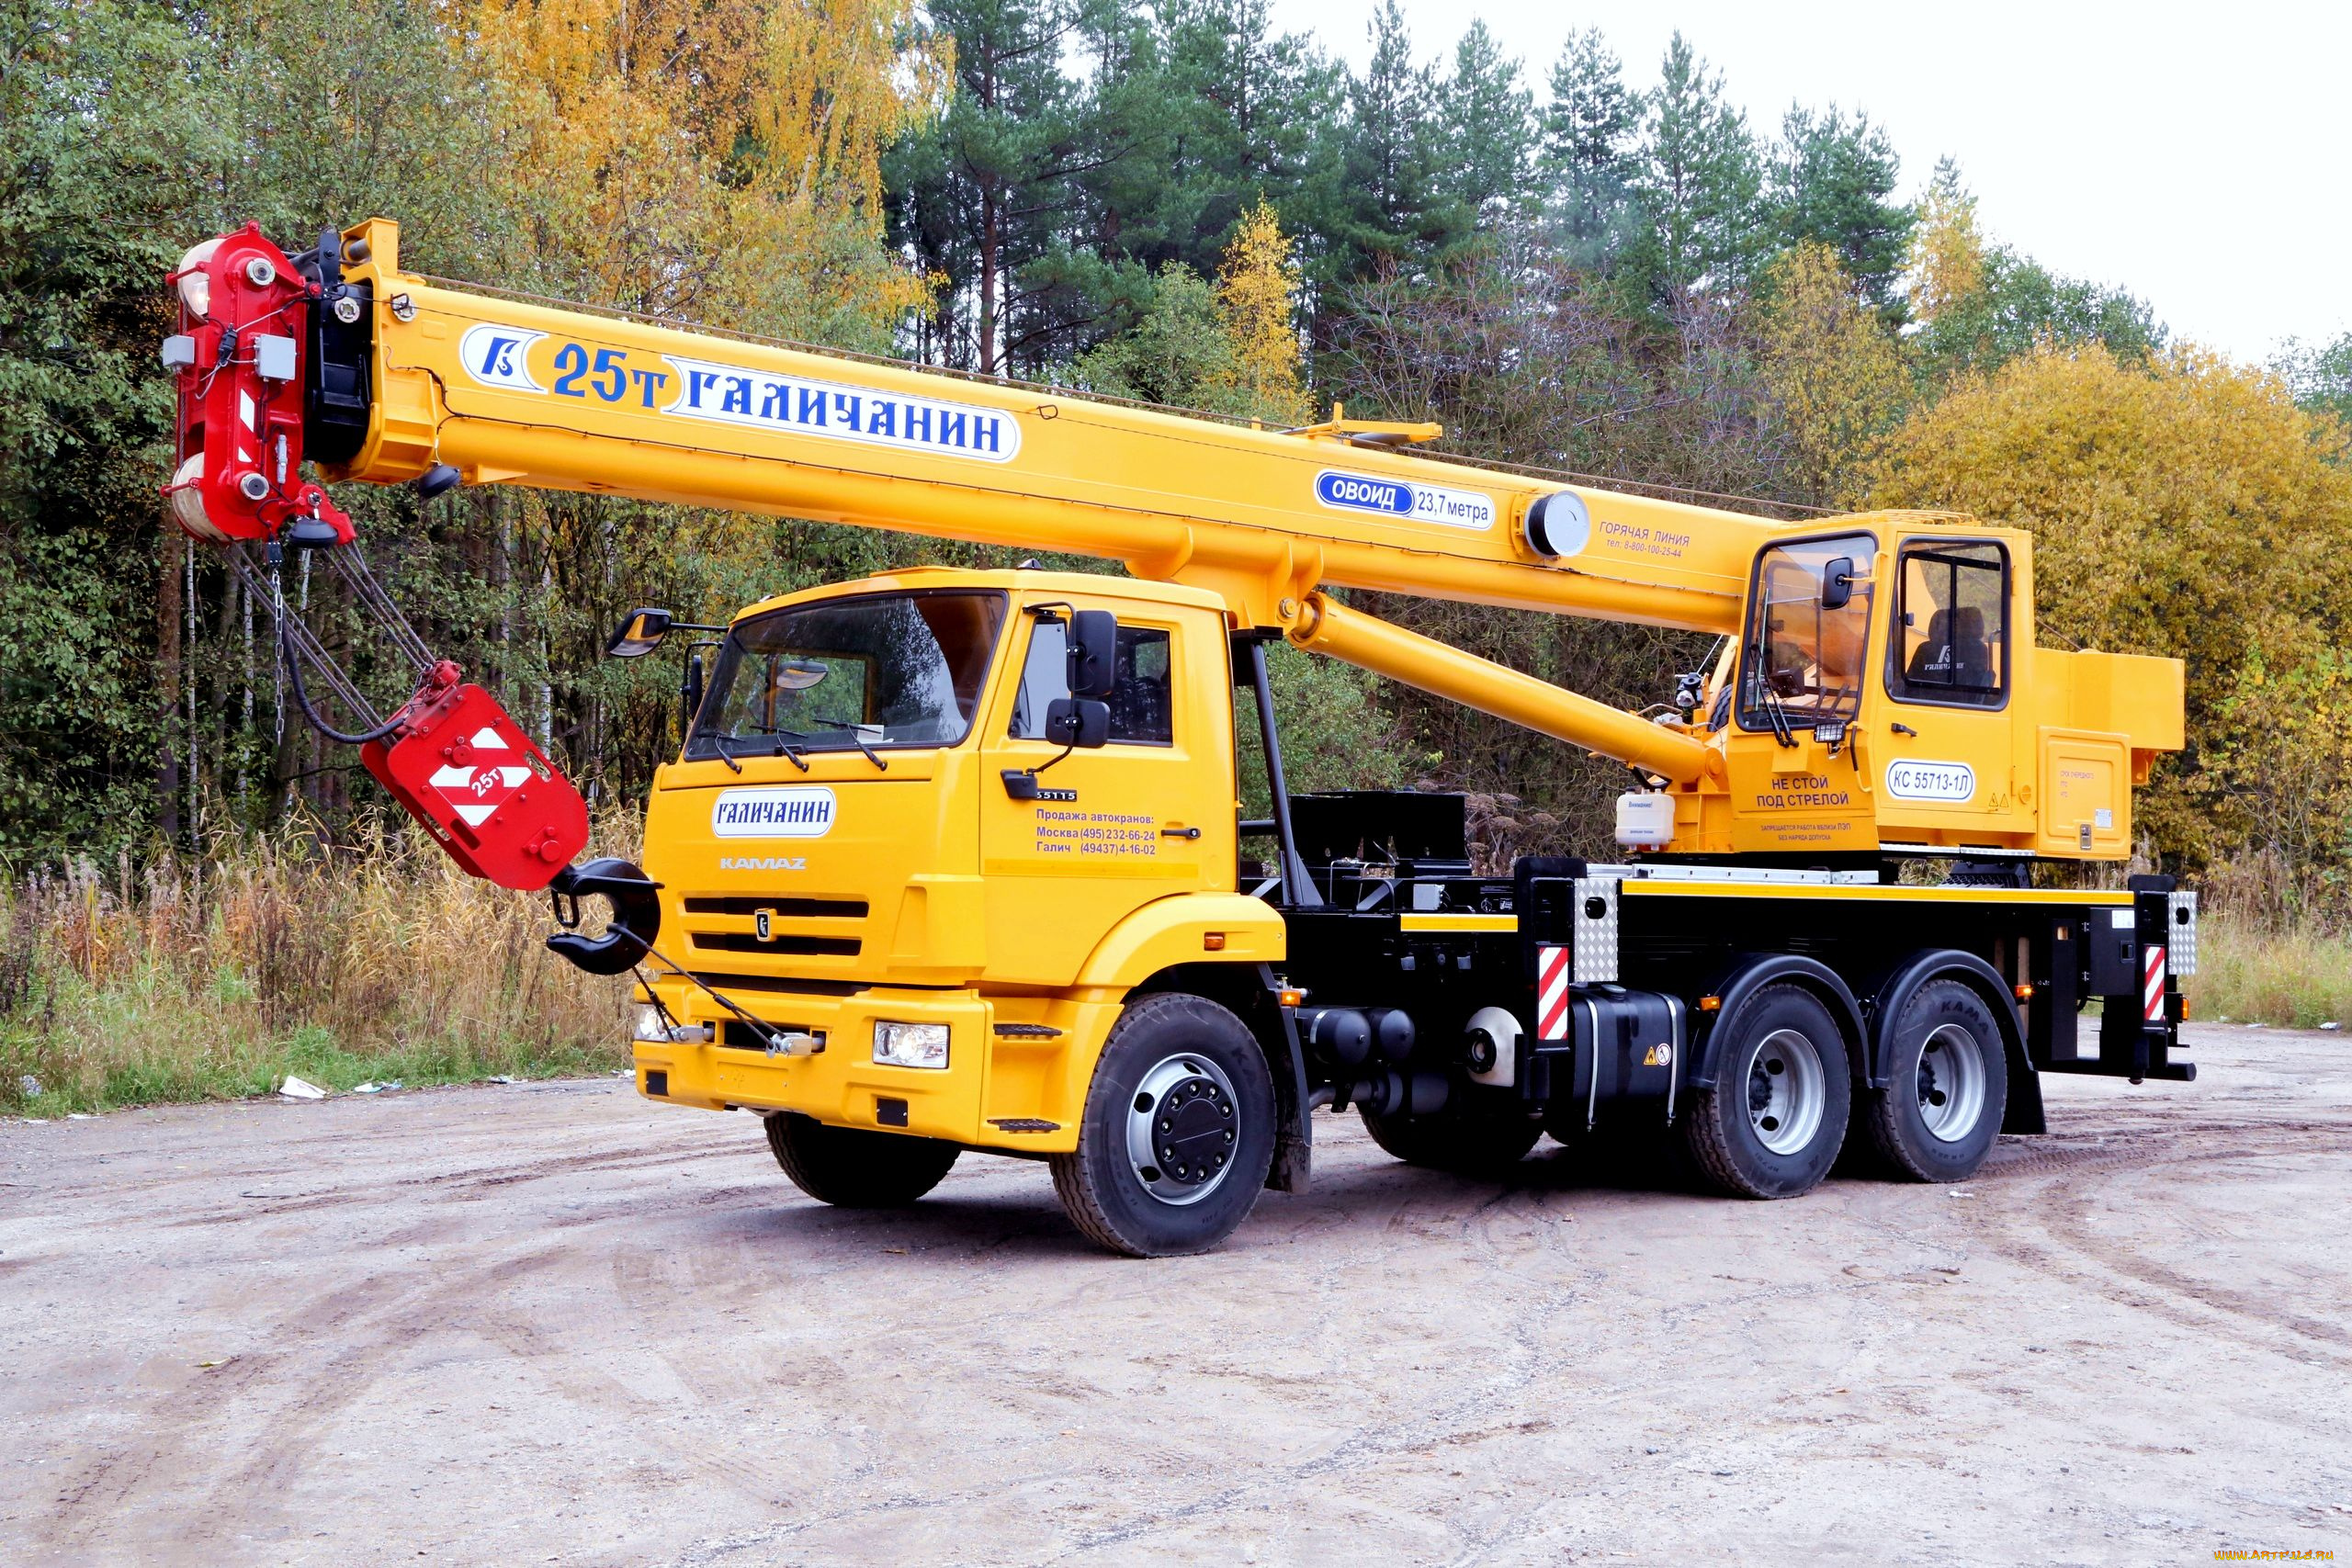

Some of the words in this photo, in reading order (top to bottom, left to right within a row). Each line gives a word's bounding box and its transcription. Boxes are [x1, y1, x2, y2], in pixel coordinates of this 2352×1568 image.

[688, 369, 1001, 453] ГАЛИЧАНИН
[1332, 479, 1396, 511] ОВОИД
[1418, 491, 1446, 516] 23,7
[1447, 502, 1488, 524] метра
[1600, 521, 1649, 540] ГОРЯЧАЯ
[1654, 531, 1690, 547] ЛИНИЯ
[1624, 540, 1681, 558] 8-800-100-25-44
[1772, 779, 1789, 790] НЕ
[1792, 775, 1828, 790] СТОЙ
[1894, 771, 1911, 788] КС
[1914, 772, 1969, 792] 55713-1Л
[1757, 795, 1785, 808] ПОД
[1787, 791, 1849, 807] СТРЕЛОЙ
[717, 801, 831, 824] ГАЛИЧАНИН
[1036, 808, 1087, 822] Продажа
[1091, 813, 1154, 825] автокранов:
[1036, 827, 1079, 838] Москва
[1036, 841, 1071, 852] Галич
[719, 857, 807, 870] KAMAZ
